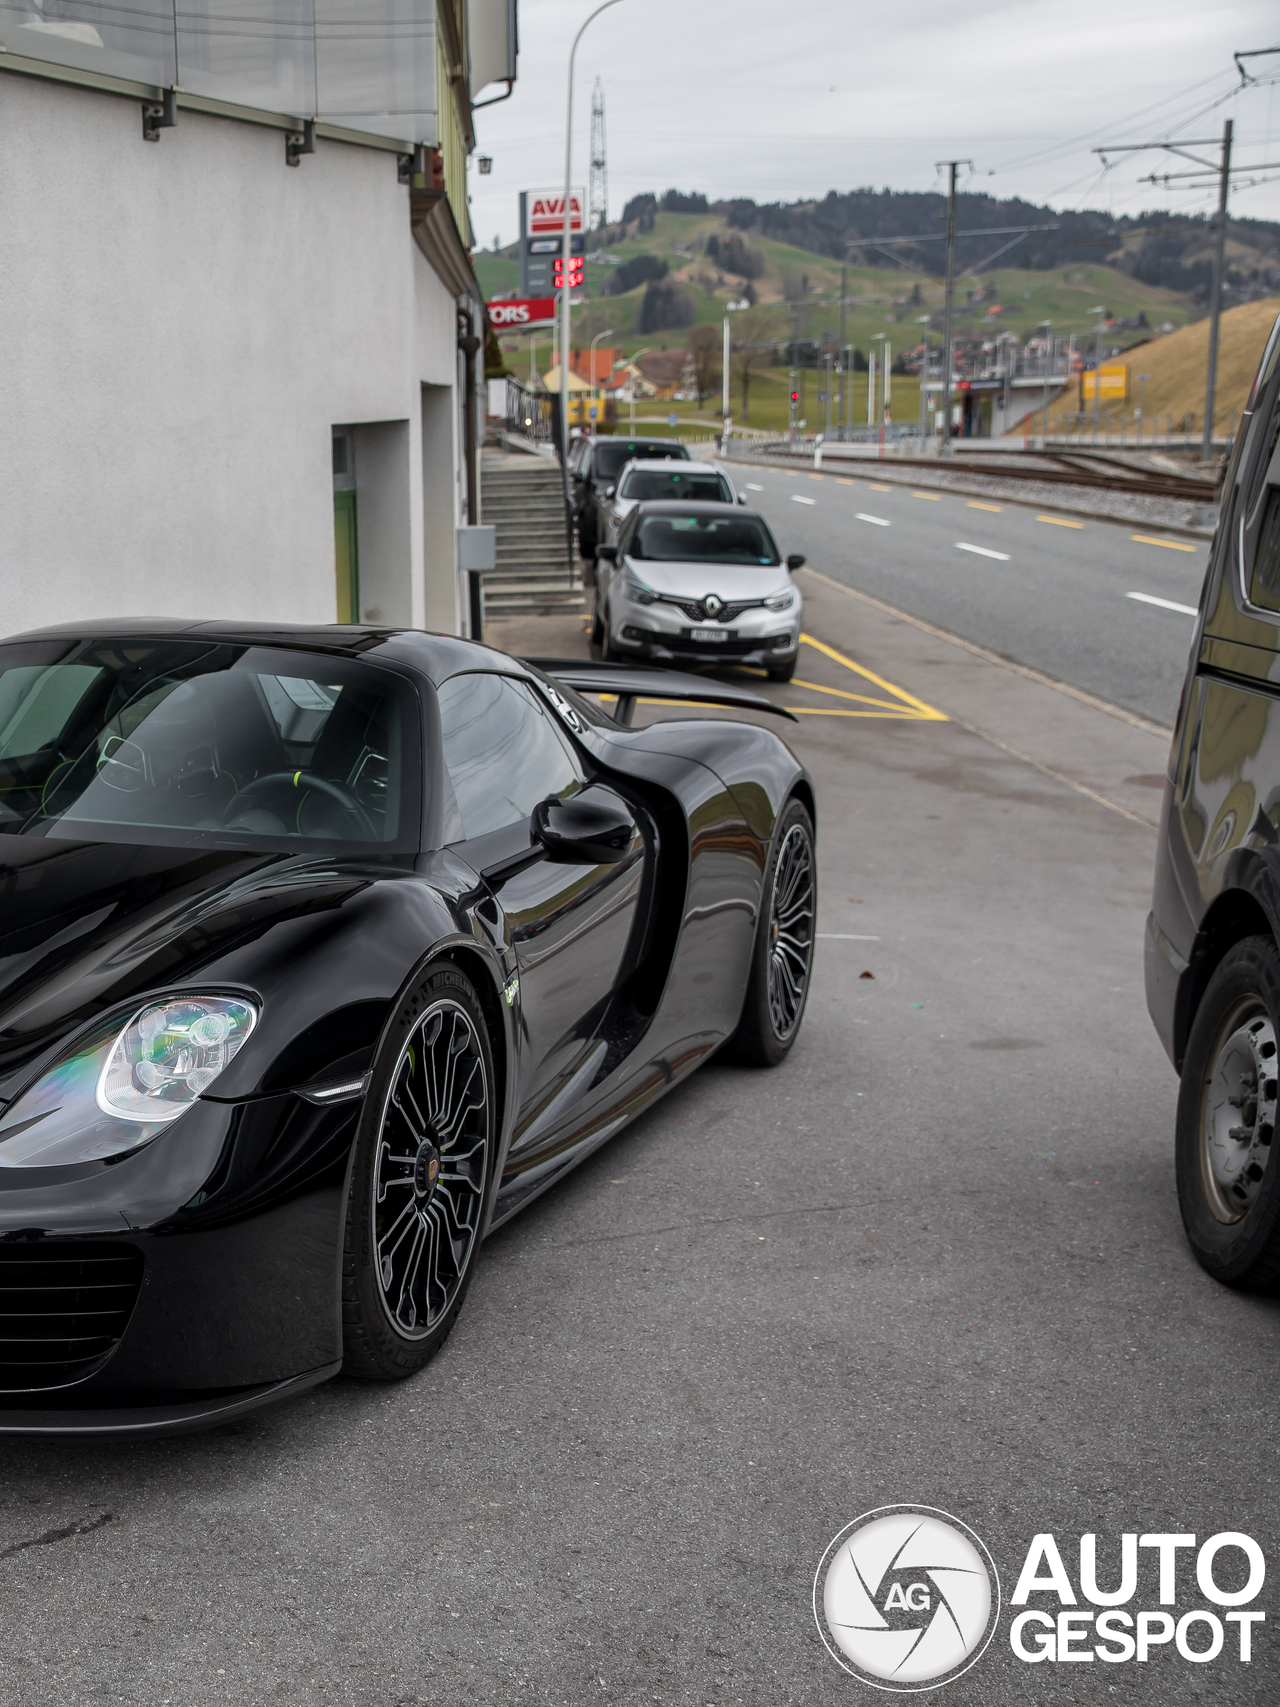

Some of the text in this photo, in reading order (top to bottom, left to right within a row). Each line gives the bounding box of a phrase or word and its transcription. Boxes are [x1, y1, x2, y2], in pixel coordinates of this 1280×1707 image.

[532, 197, 580, 216] AVIA
[488, 304, 530, 324] ORS
[432, 971, 473, 997] MICHELIN
